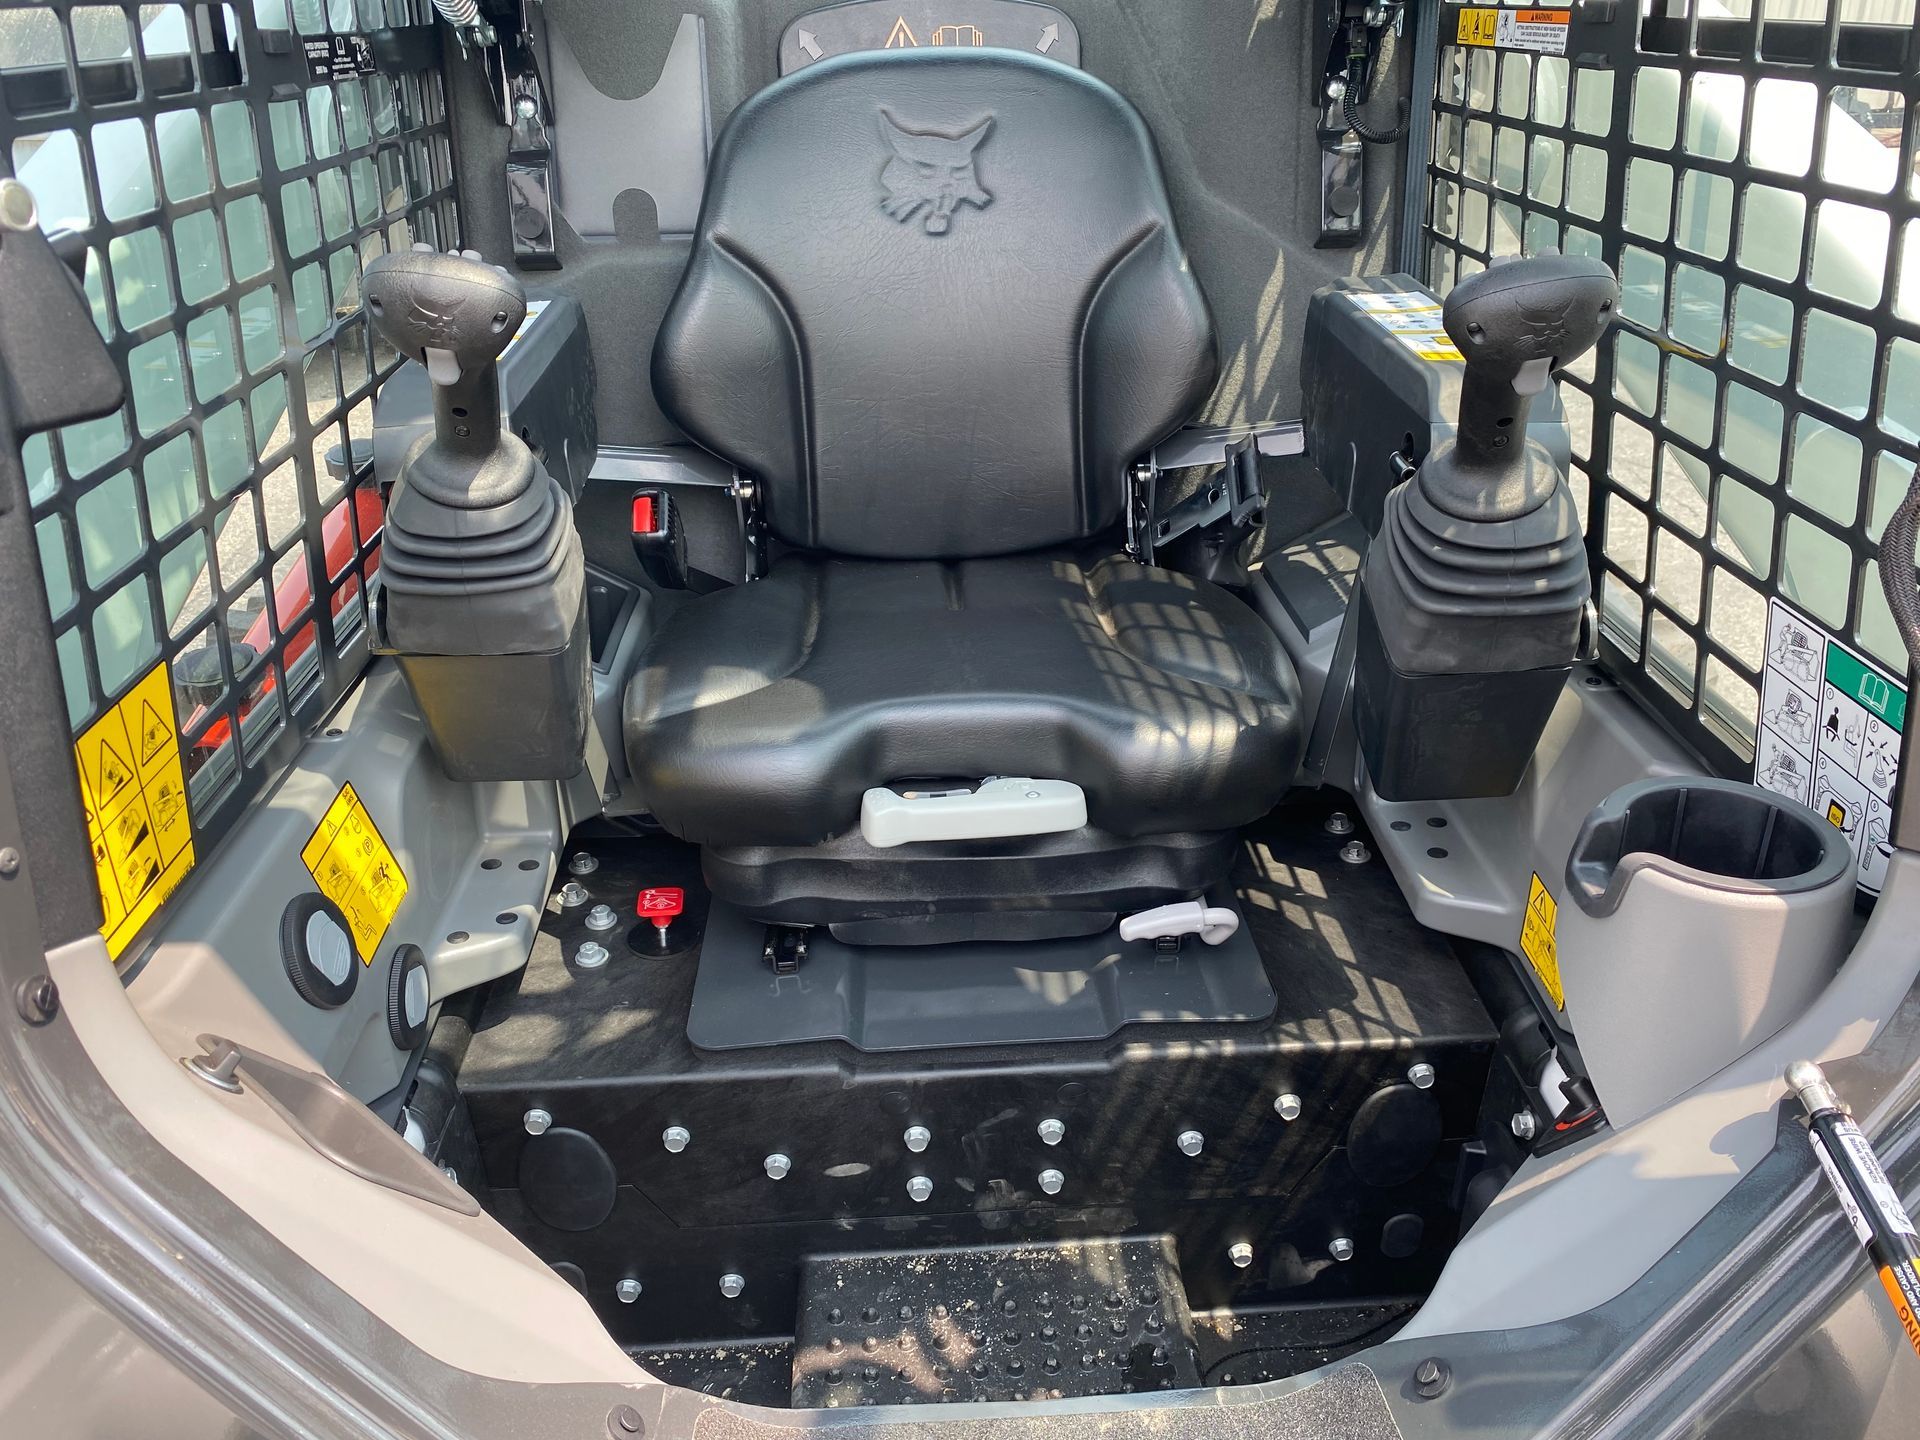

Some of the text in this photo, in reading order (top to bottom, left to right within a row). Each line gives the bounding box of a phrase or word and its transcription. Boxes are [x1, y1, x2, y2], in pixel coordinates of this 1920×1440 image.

[1534, 13, 1553, 21] WARNING
[1830, 812, 1840, 824] ISO
[1848, 1136, 1862, 1154] WIRE
[1860, 1154, 1880, 1184] REMOVE
[1894, 1265, 1910, 1290] CAUSE
[1906, 1290, 1919, 1307] AND
